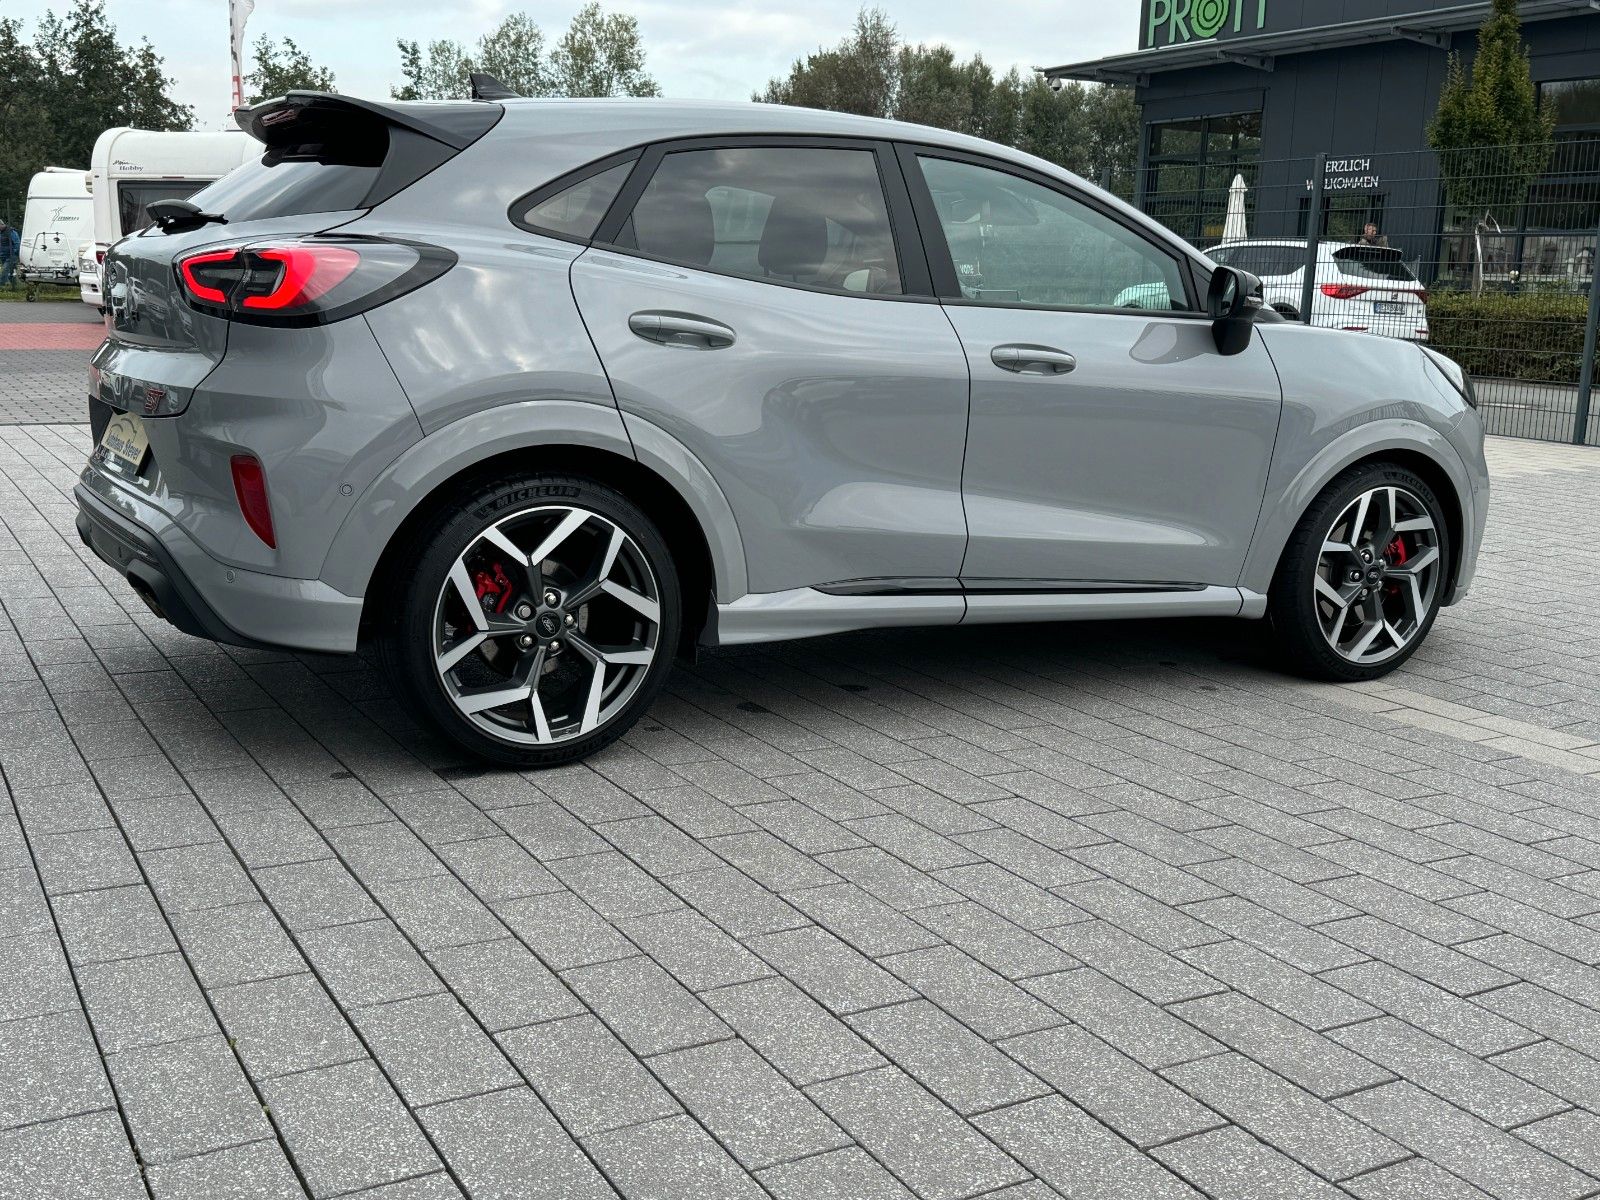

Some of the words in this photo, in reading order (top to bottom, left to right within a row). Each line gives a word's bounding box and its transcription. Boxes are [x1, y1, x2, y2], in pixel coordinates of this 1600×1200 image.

[1325, 159, 1370, 172] ERZLICH
[1306, 176, 1379, 190] WLKOMMEN
[496, 487, 576, 507] MICHELIN
